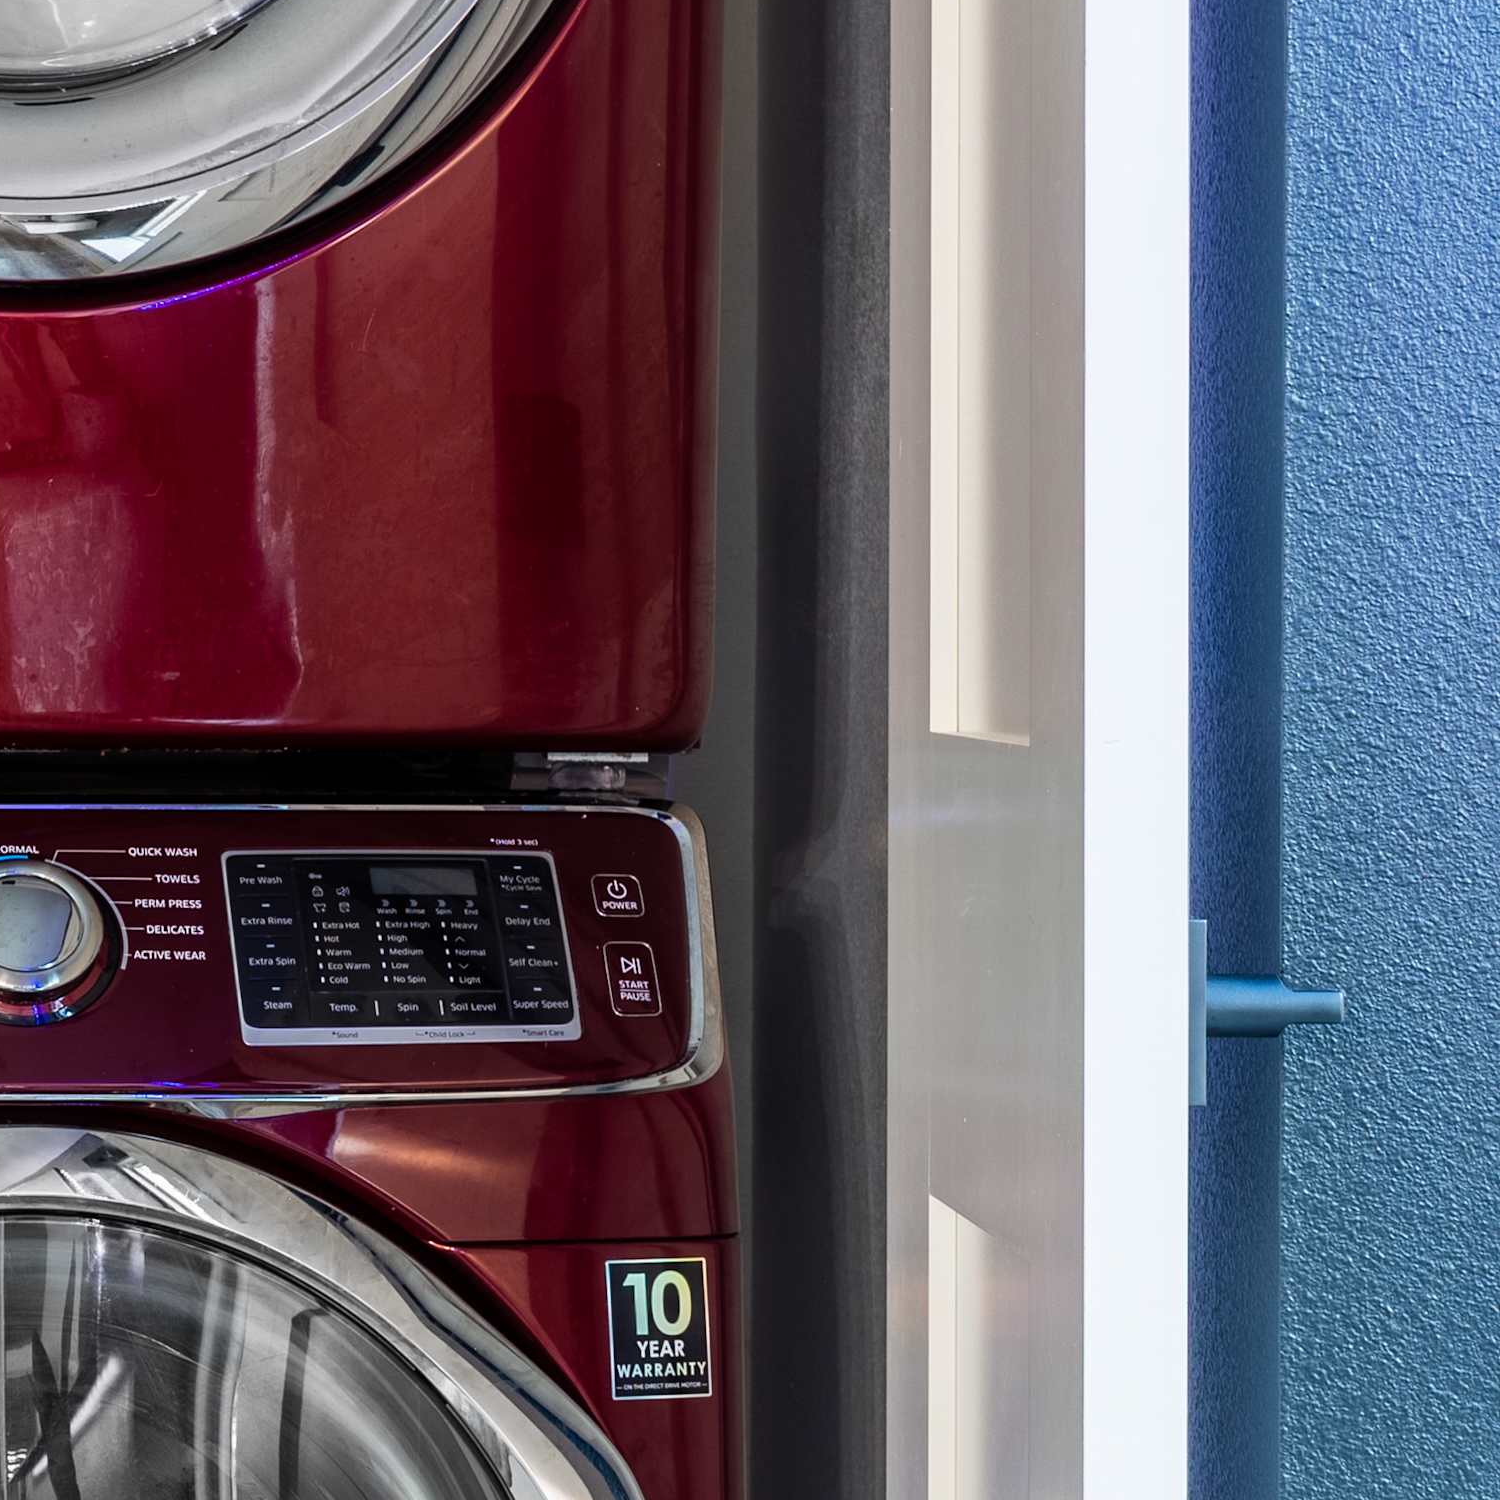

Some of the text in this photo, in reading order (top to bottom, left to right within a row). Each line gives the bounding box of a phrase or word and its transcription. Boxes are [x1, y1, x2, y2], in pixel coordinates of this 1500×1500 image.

[128, 846, 198, 857] QUICK WASH
[154, 873, 201, 884] TOWELS
[239, 876, 283, 885] Pre Wash
[500, 875, 541, 886] My Cycle
[134, 898, 203, 909] PERM PRESS
[602, 900, 638, 910] POWER
[376, 907, 397, 915] Wash
[241, 916, 293, 926] Extra Rinse
[321, 921, 361, 930] Extra Hot
[385, 920, 431, 931] Extra High
[505, 917, 551, 927] Delay End
[145, 924, 205, 935] DELICATES
[450, 922, 479, 931] Heavy
[324, 934, 340, 943] Hot
[387, 934, 408, 944] High
[132, 949, 207, 961] ACTIVE WEAR
[325, 948, 352, 957] Warm
[389, 947, 424, 956] Medium
[455, 948, 487, 957] Normal
[248, 956, 297, 967] Extra Spin
[327, 962, 371, 971] Eco Warm
[391, 961, 410, 970] Low
[508, 957, 526, 967] Self
[328, 975, 349, 984] Cold
[392, 975, 427, 985] No Spin
[458, 975, 482, 985] Light
[618, 980, 650, 990] START
[620, 991, 652, 1002] PAUSE
[263, 1000, 293, 1011] Steam
[329, 1003, 358, 1013] Temp.
[396, 1002, 420, 1013] Spin
[450, 1002, 497, 1011] Soil Level
[513, 1000, 570, 1011] Super Speed
[549, 1029, 566, 1037] Care
[622, 1270, 692, 1336] 10
[636, 1339, 686, 1359] YEAR
[616, 1361, 707, 1379] WARRANTY
[681, 1381, 701, 1389] MOTOR
